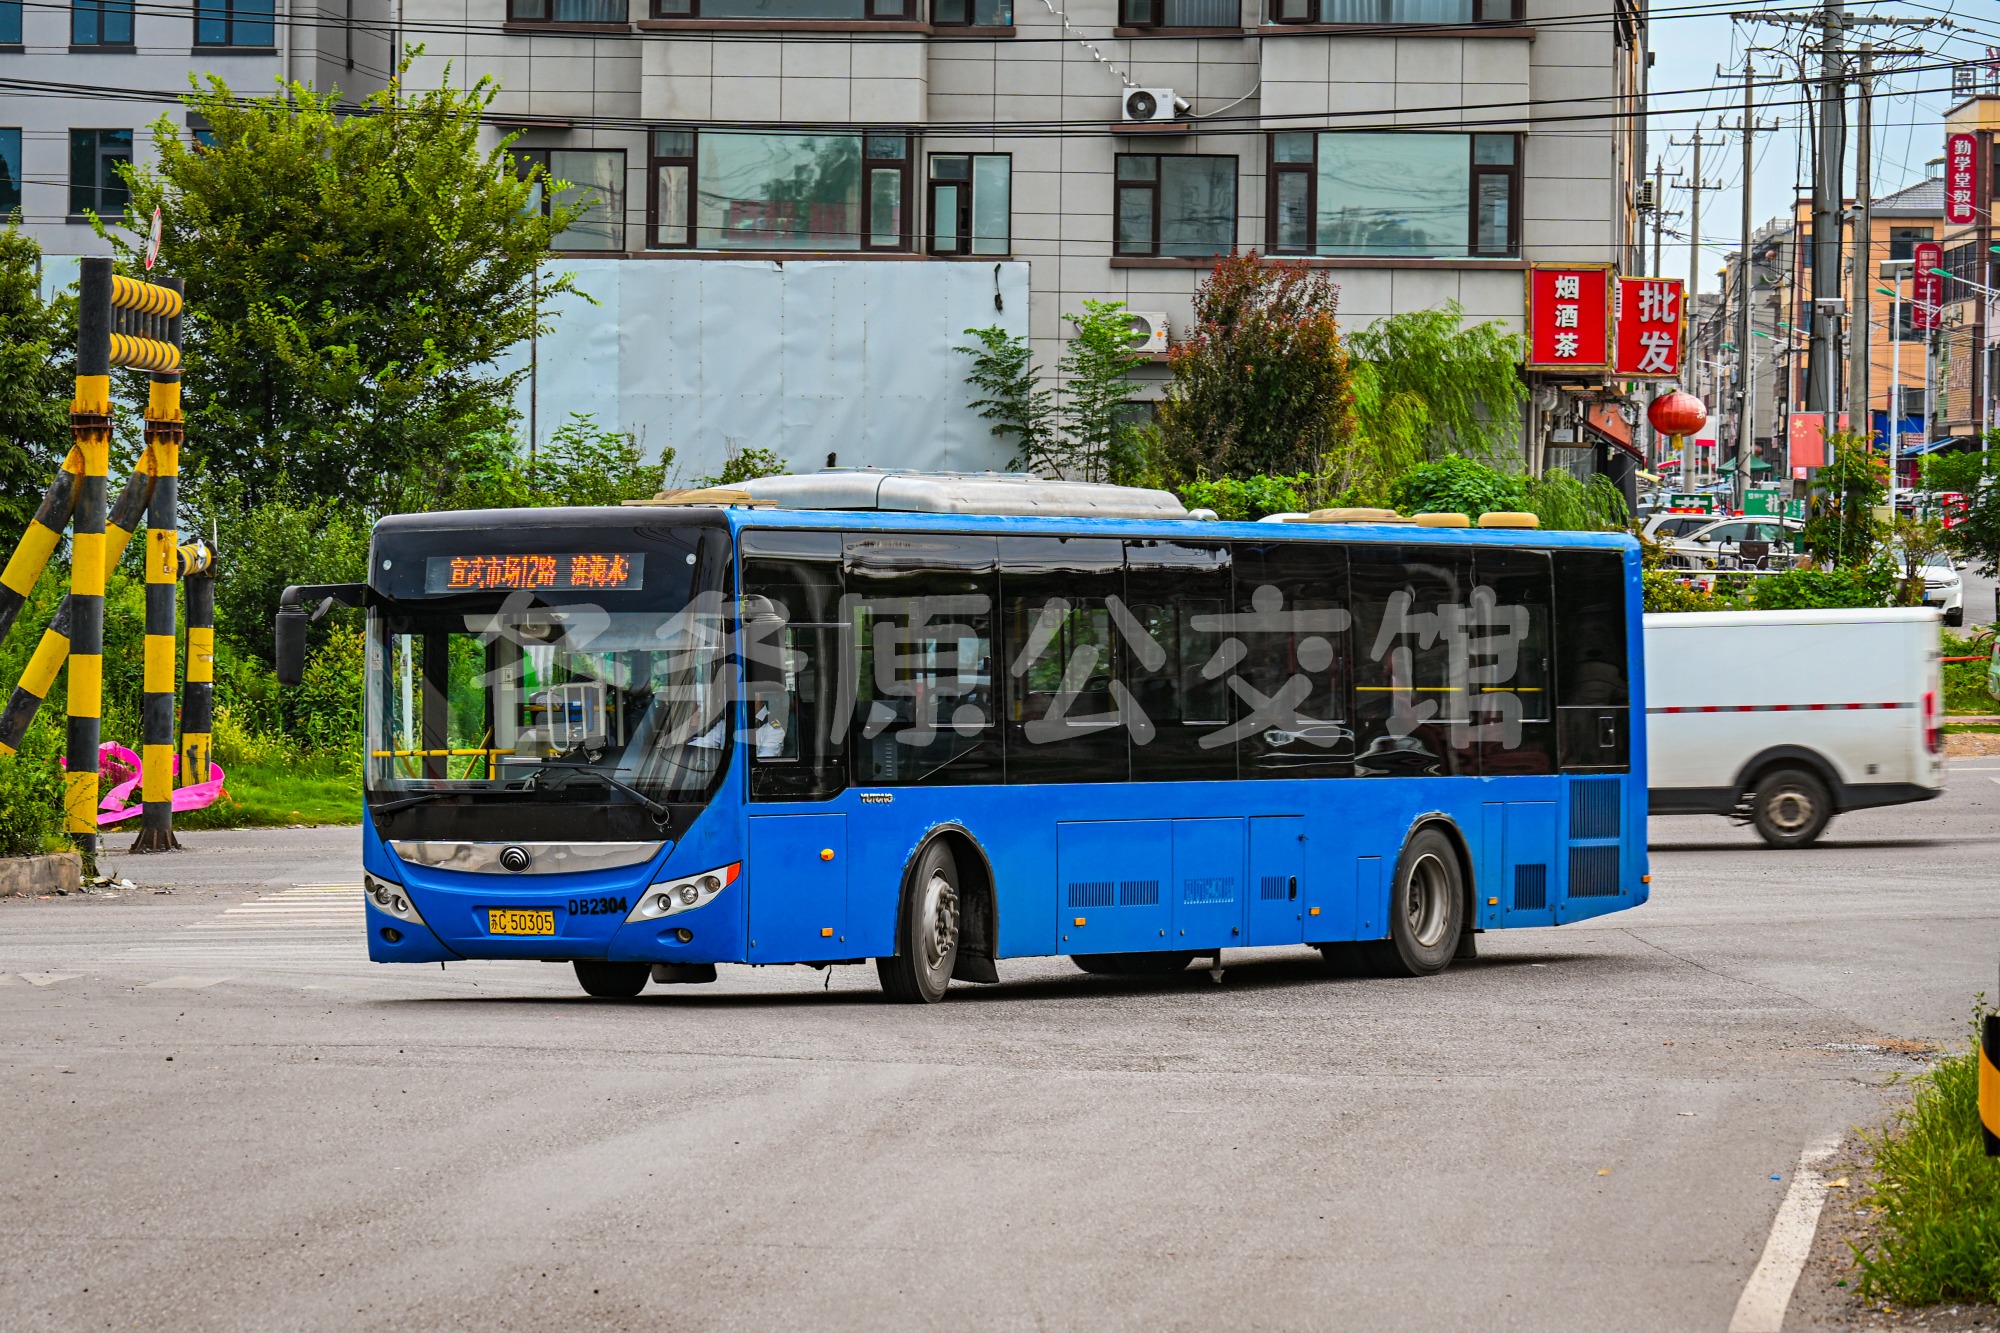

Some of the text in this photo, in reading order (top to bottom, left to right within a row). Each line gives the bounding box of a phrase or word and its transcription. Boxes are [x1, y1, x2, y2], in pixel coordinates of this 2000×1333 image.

[1954, 140, 1971, 217] 勤学堂教育
[1554, 275, 1580, 358] 烟酒茶
[1637, 282, 1677, 373] 批发
[447, 555, 558, 589] 宣武市场12路
[568, 897, 628, 916] DB2304
